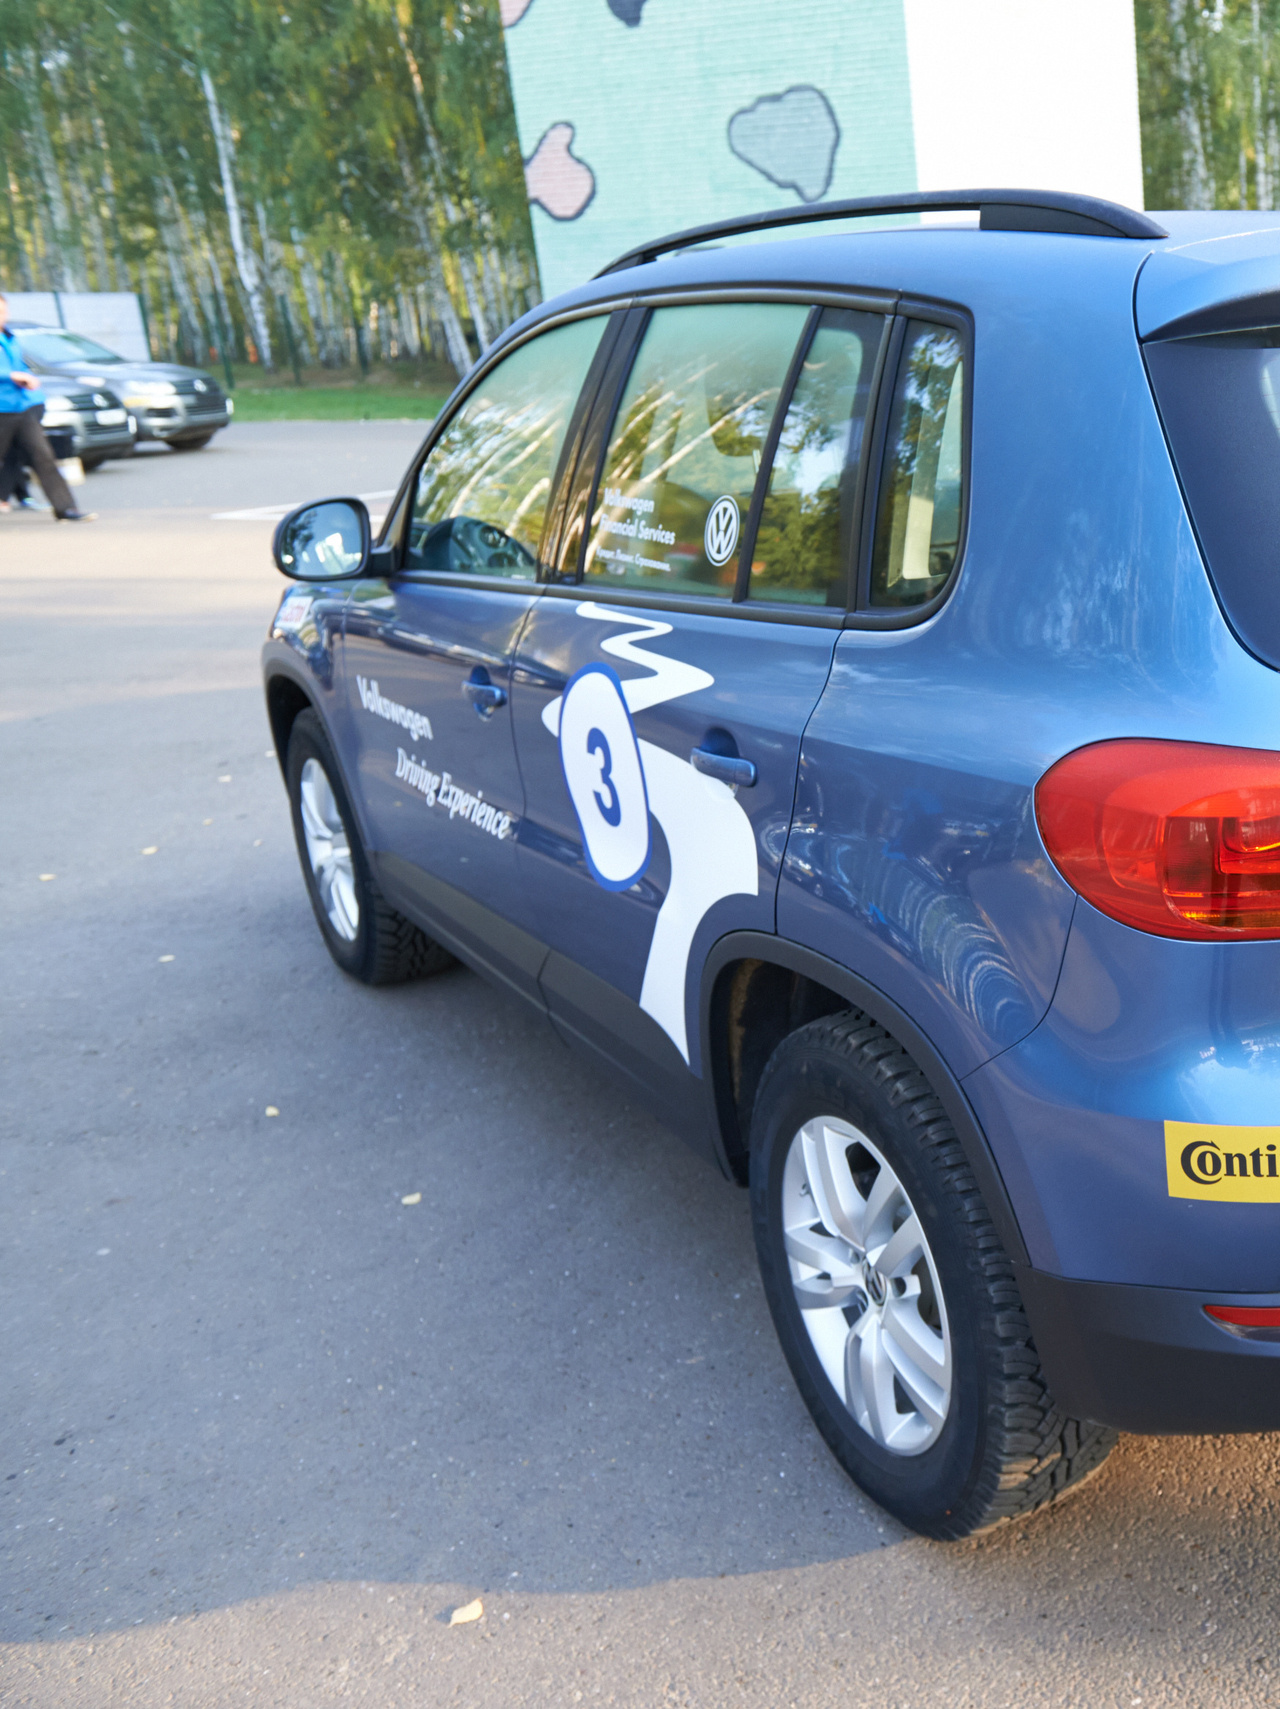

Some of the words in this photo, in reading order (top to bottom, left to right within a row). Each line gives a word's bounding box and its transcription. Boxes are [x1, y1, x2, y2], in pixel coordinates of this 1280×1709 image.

[638, 520, 676, 545] Services
[356, 674, 433, 741] Volkswagen
[395, 747, 440, 807] Driving
[438, 771, 511, 840] Experience
[586, 726, 622, 827] 3
